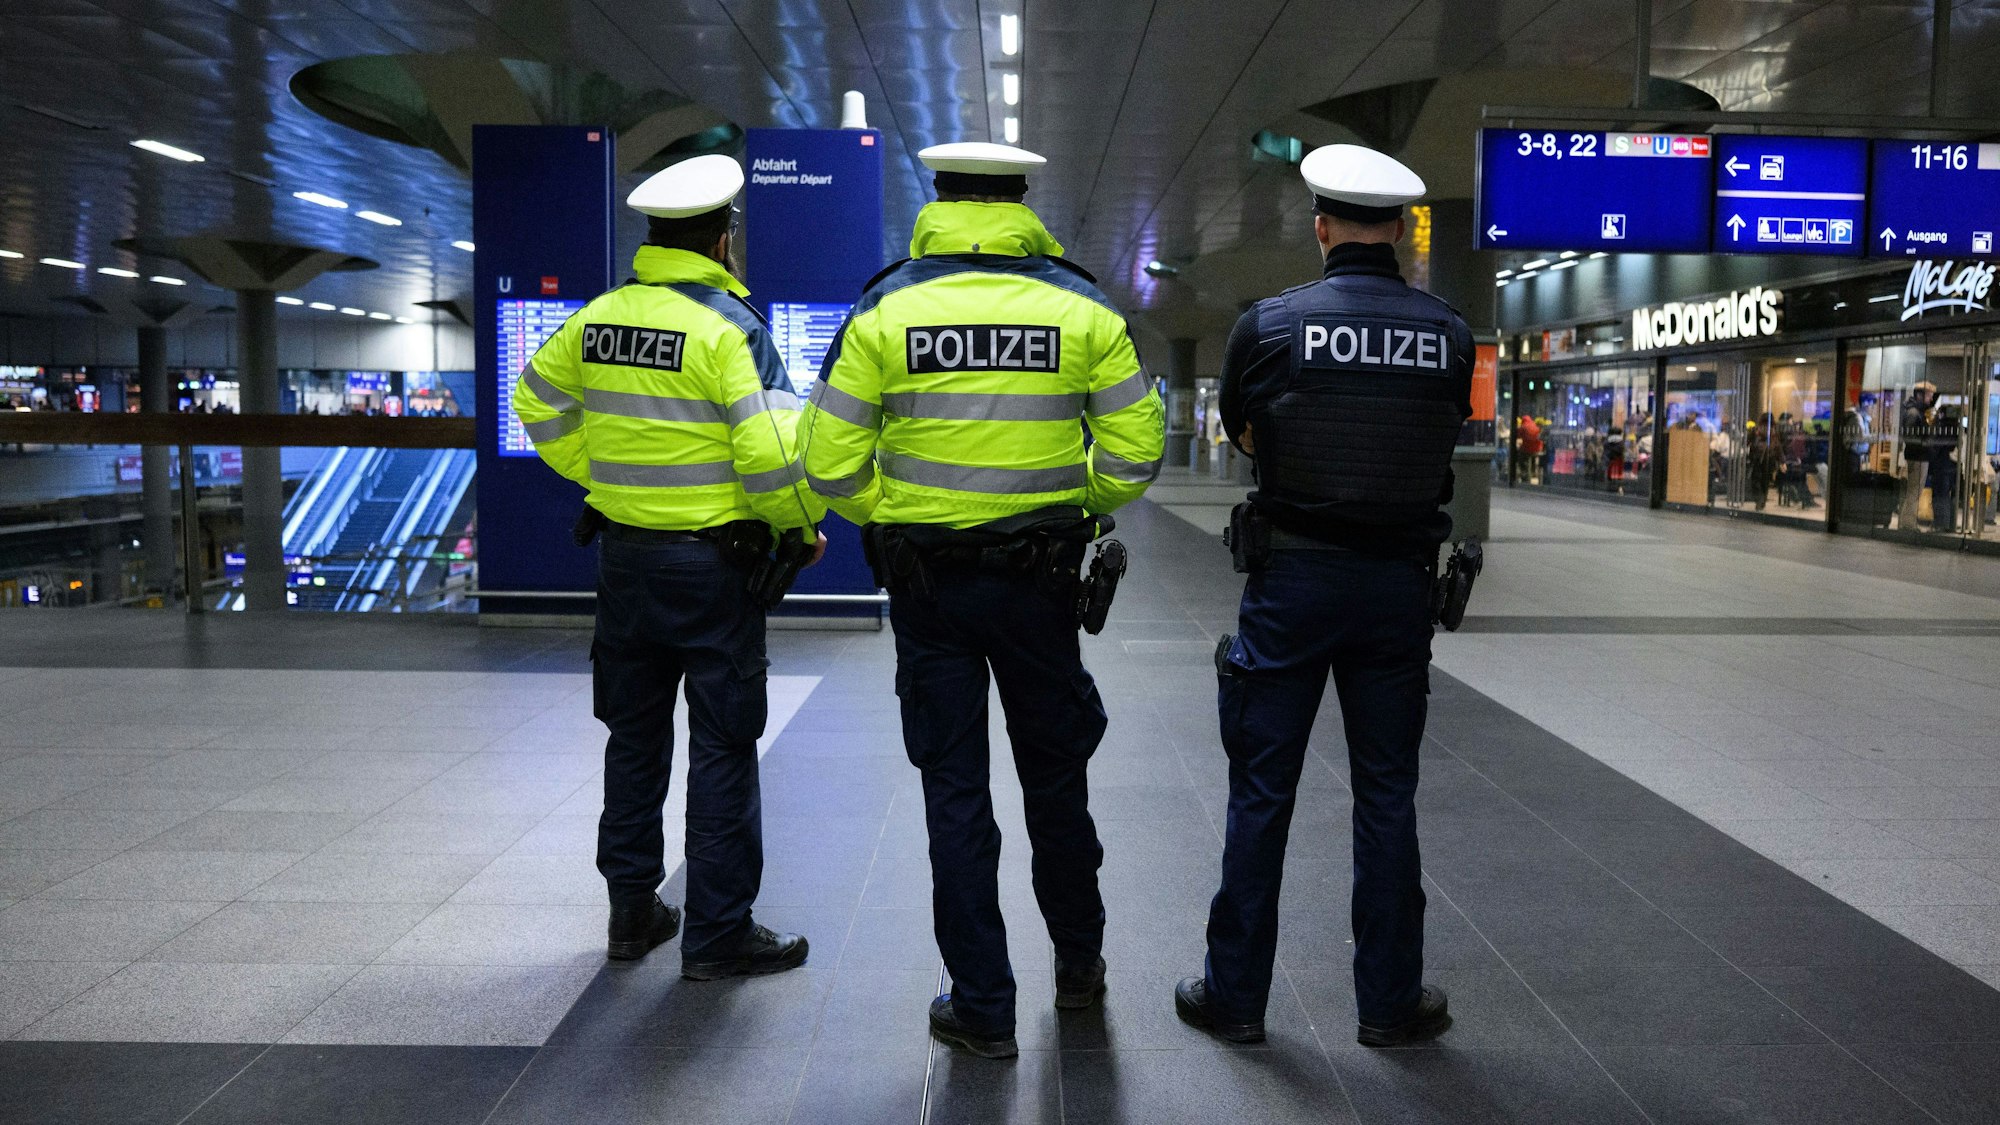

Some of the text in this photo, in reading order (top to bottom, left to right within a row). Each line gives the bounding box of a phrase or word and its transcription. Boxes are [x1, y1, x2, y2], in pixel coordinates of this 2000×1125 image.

[1517, 132, 1562, 160] 3-8,
[1569, 133, 1597, 157] 22
[1614, 135, 1630, 154] S
[1655, 137, 1668, 154] U
[1673, 141, 1689, 150] BUS
[1693, 142, 1708, 150] Tram
[1911, 144, 1968, 171] 11-16
[752, 158, 797, 172] Abfahrt
[751, 173, 833, 187] Departure Départ
[1783, 232, 1802, 241] Lounge
[1806, 229, 1823, 241] WC
[1835, 228, 1846, 243] P
[1907, 229, 1948, 244] Ausgang
[498, 277, 512, 293] U
[1632, 286, 1778, 351] McDonald's
[582, 325, 683, 368] POLIZEI
[909, 327, 1059, 370] POLIZEI
[1304, 325, 1448, 370] POLIZEI
